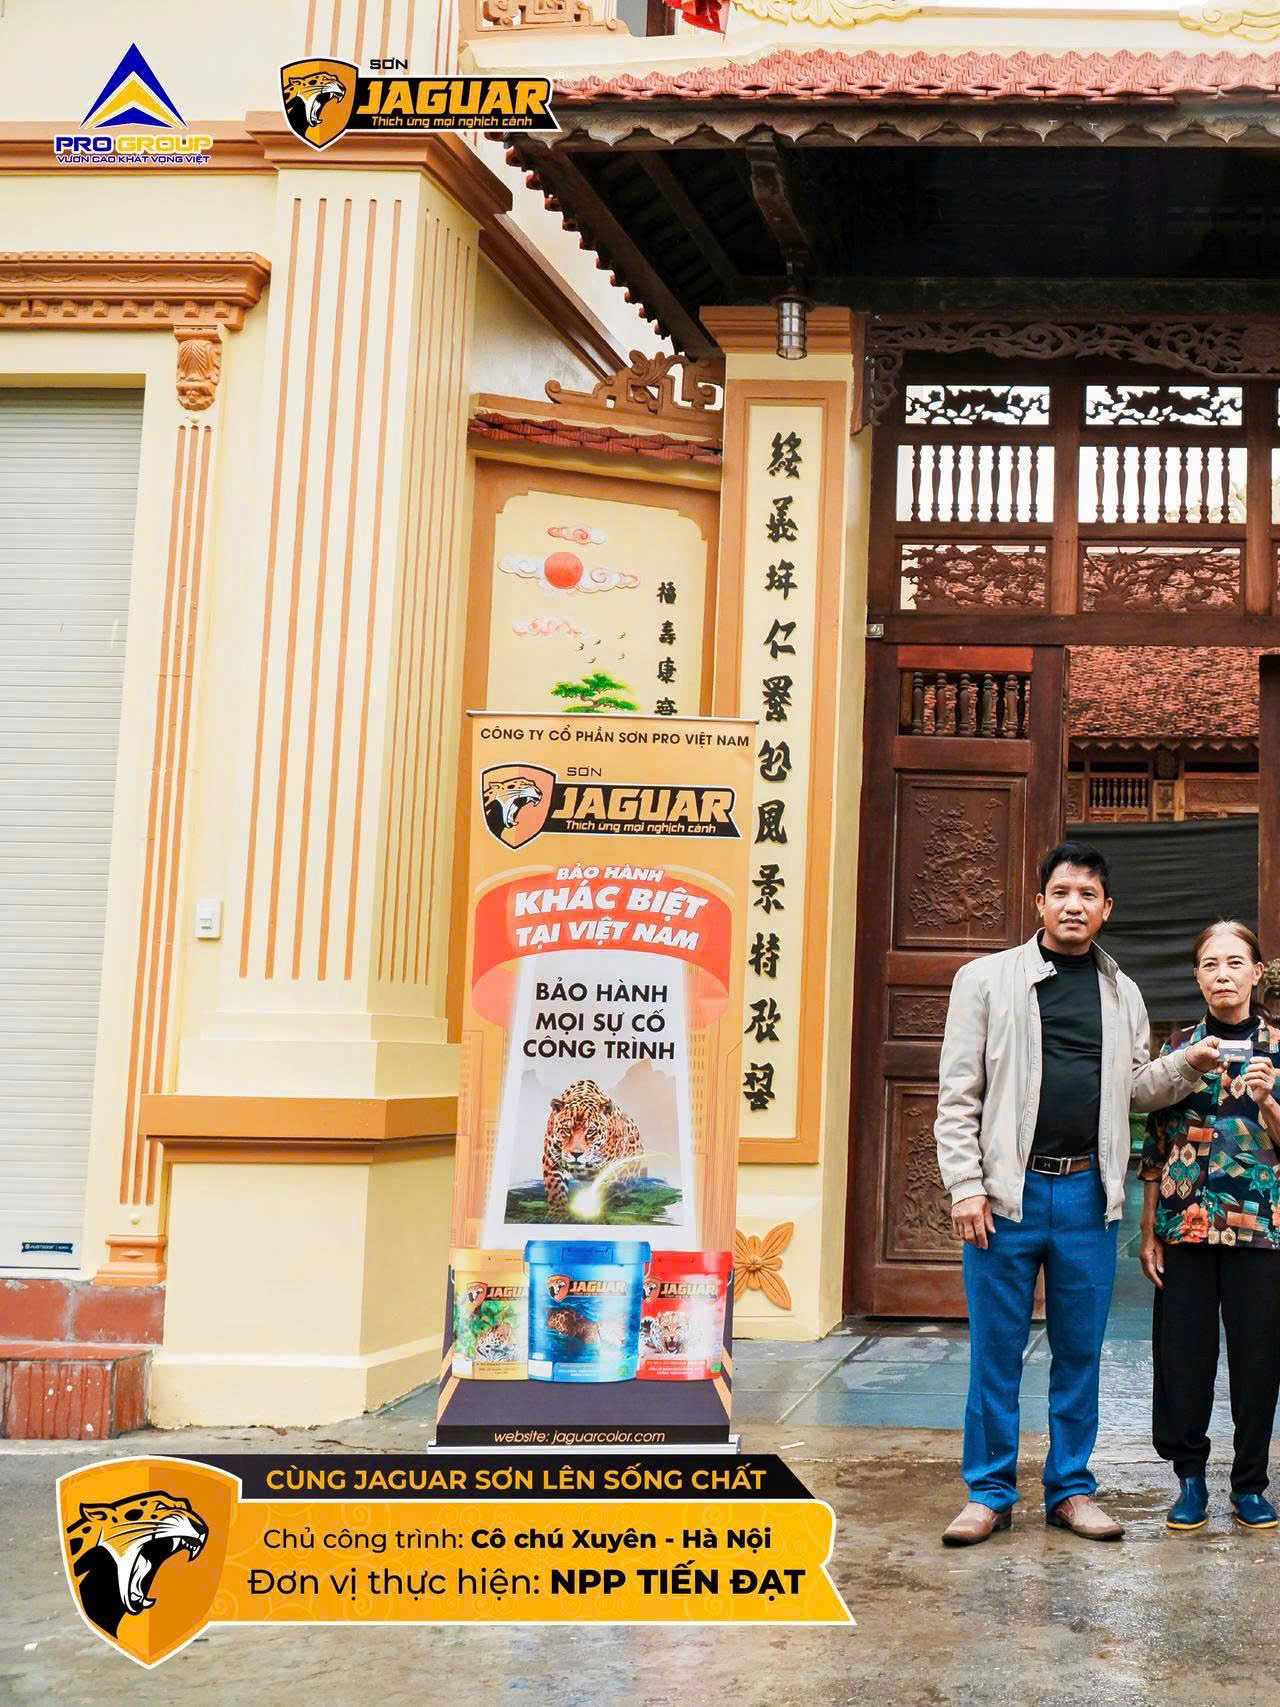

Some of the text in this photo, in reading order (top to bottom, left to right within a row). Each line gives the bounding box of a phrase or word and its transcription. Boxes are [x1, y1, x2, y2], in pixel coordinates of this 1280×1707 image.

[480, 726, 525, 740] CÔNG
[529, 729, 544, 741] TY
[549, 724, 572, 741] CỔ
[618, 731, 648, 744] SƠN
[652, 733, 681, 745] PRO
[685, 731, 713, 748] VIỆT
[717, 735, 750, 747] NAM
[566, 764, 602, 777] SƠN
[551, 787, 736, 823] JAGUAR
[623, 822, 645, 833] mọi
[648, 822, 685, 835] nghịch
[556, 862, 665, 883] BẢO HÀNH
[514, 879, 709, 922] KHÁC BIỆT
[515, 916, 700, 951] TẠI VIỆT NAM
[535, 976, 668, 1003] BẢO HÀNH
[535, 1008, 666, 1037] MỌI SỰ CỐ
[523, 1035, 675, 1060] CÔNG TRÌNH
[569, 1281, 626, 1293] JAGUAR
[660, 1284, 717, 1296] JAGUAR
[494, 1430, 666, 1445] website: jaguarcolor.com
